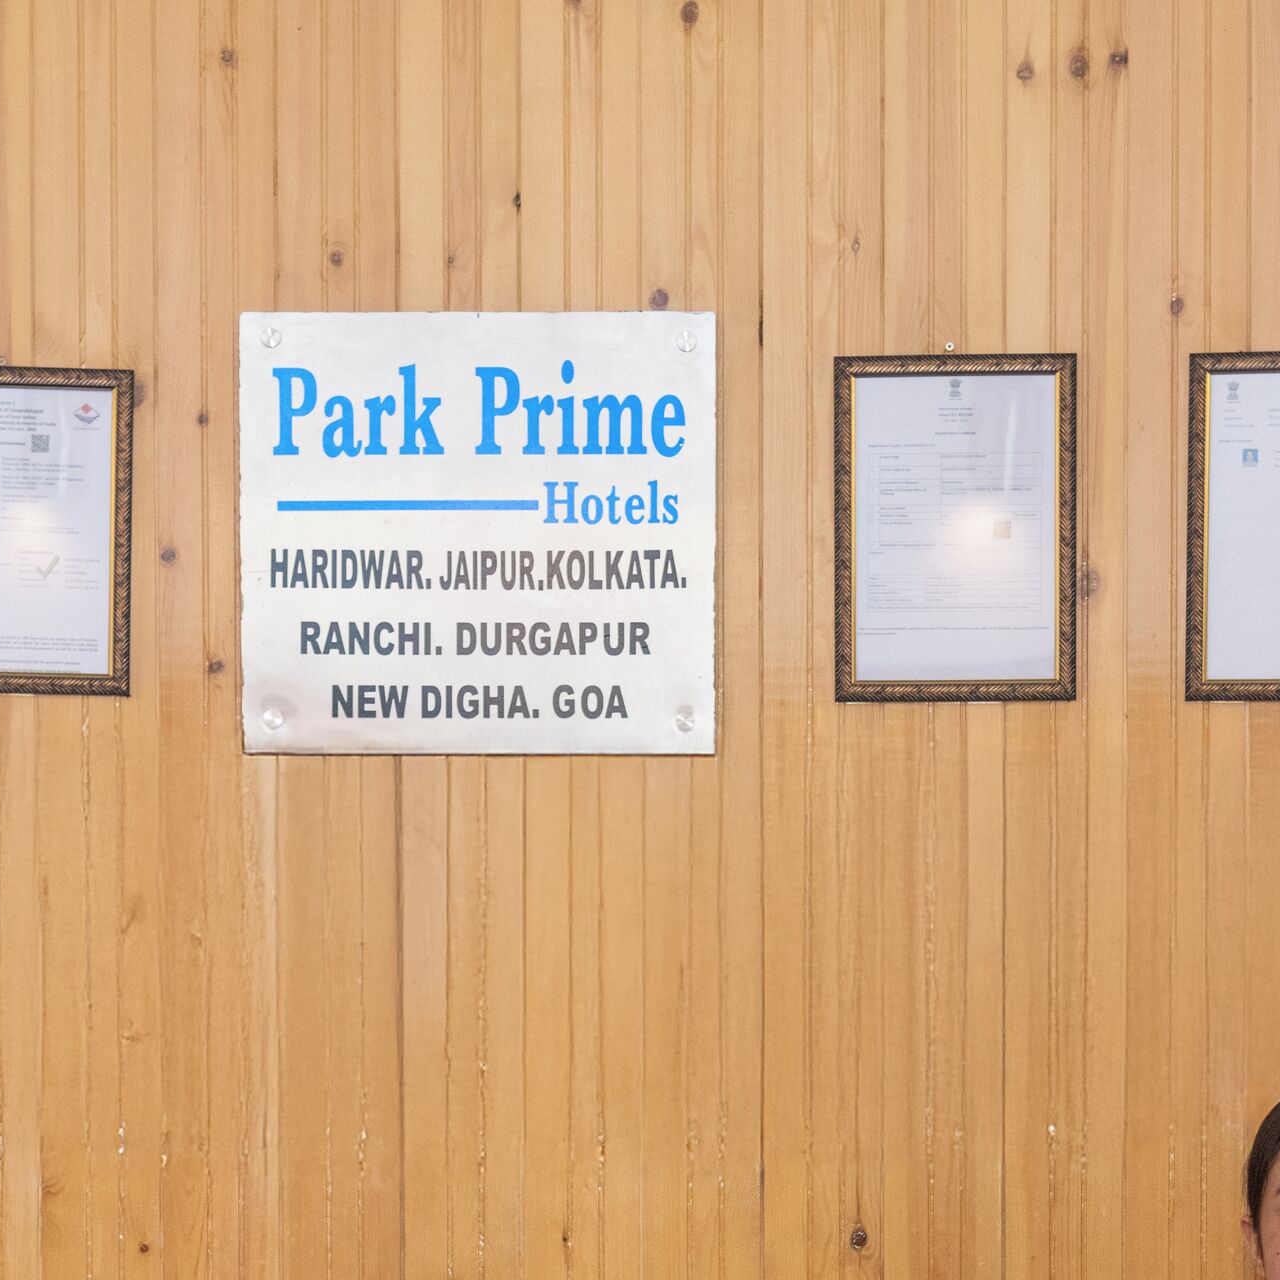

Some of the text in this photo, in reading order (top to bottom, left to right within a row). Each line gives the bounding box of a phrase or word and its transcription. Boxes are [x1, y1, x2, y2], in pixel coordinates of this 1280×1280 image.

[272, 359, 686, 458] Park Prime
[543, 480, 679, 525] Hotels
[270, 548, 431, 590] HARIDWAR.
[300, 621, 651, 656] RANCHI. DURGAPUR
[331, 685, 628, 720] NEW DIGHA. GOA
